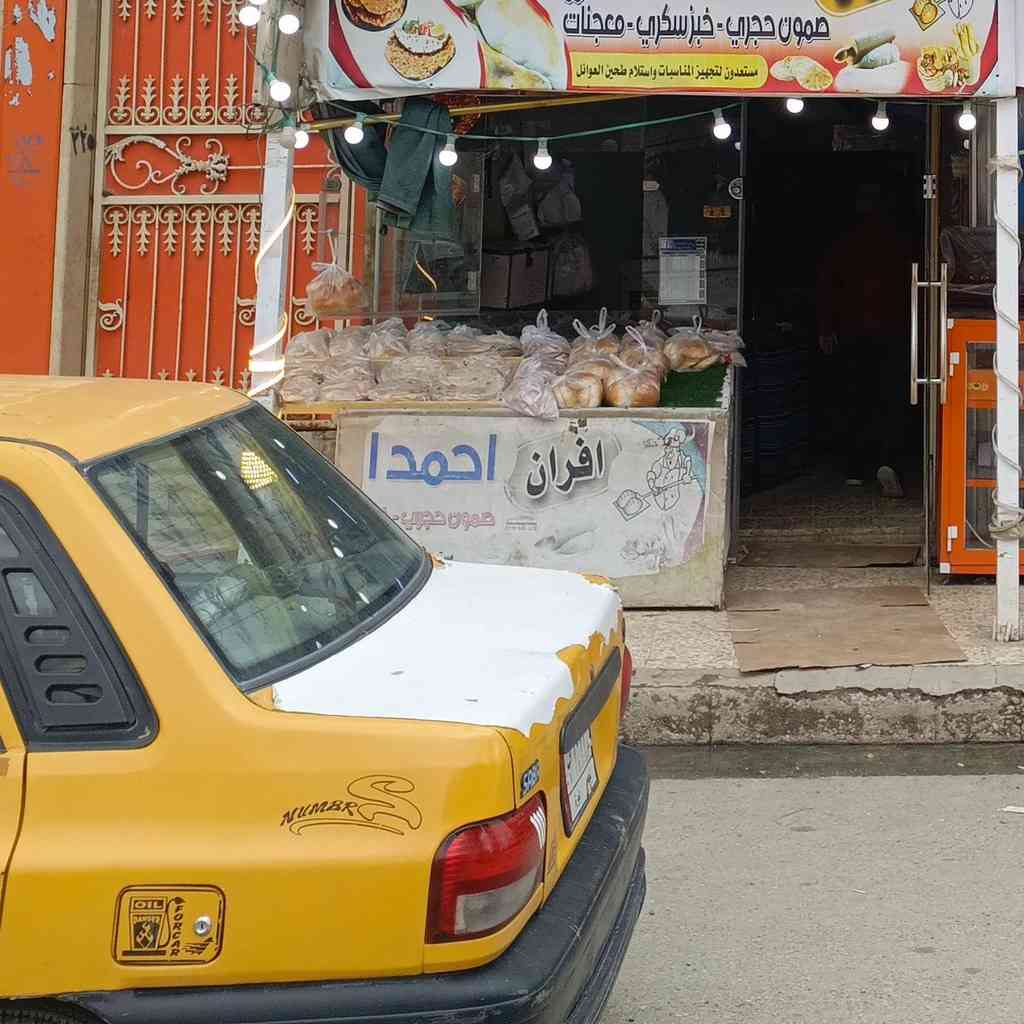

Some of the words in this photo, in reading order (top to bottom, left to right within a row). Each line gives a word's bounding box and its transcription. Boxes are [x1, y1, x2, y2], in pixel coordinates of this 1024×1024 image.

[563, 5, 625, 48] معجنات
[726, 15, 777, 49] حجري
[778, 15, 831, 49] صمون
[526, 437, 605, 499] افران
[133, 900, 163, 909] OIL
